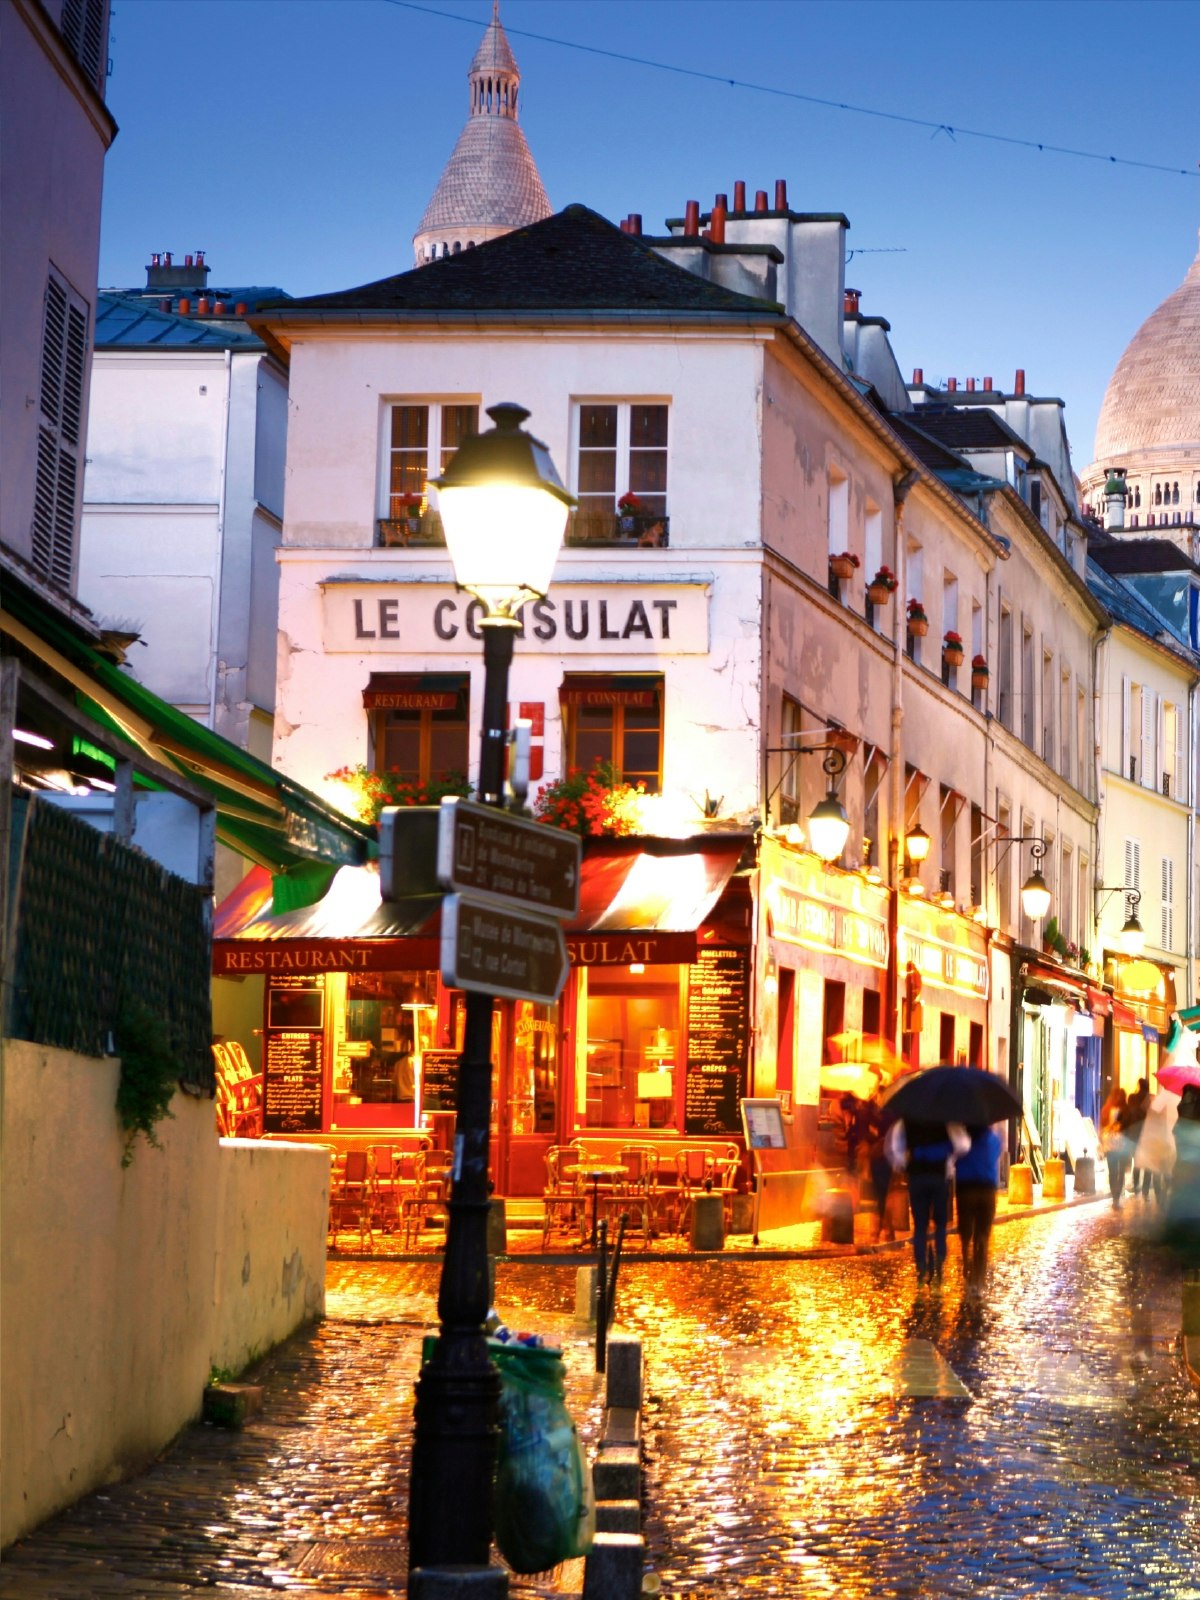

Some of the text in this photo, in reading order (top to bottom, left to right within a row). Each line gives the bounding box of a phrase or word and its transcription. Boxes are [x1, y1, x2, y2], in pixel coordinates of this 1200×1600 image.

[354, 599, 677, 640] LE COSULAT
[374, 693, 447, 708] RESTAURANT
[568, 691, 645, 705] LE CONSULAT
[225, 949, 373, 969] RESTAURANT
[567, 940, 657, 962] SULAT
